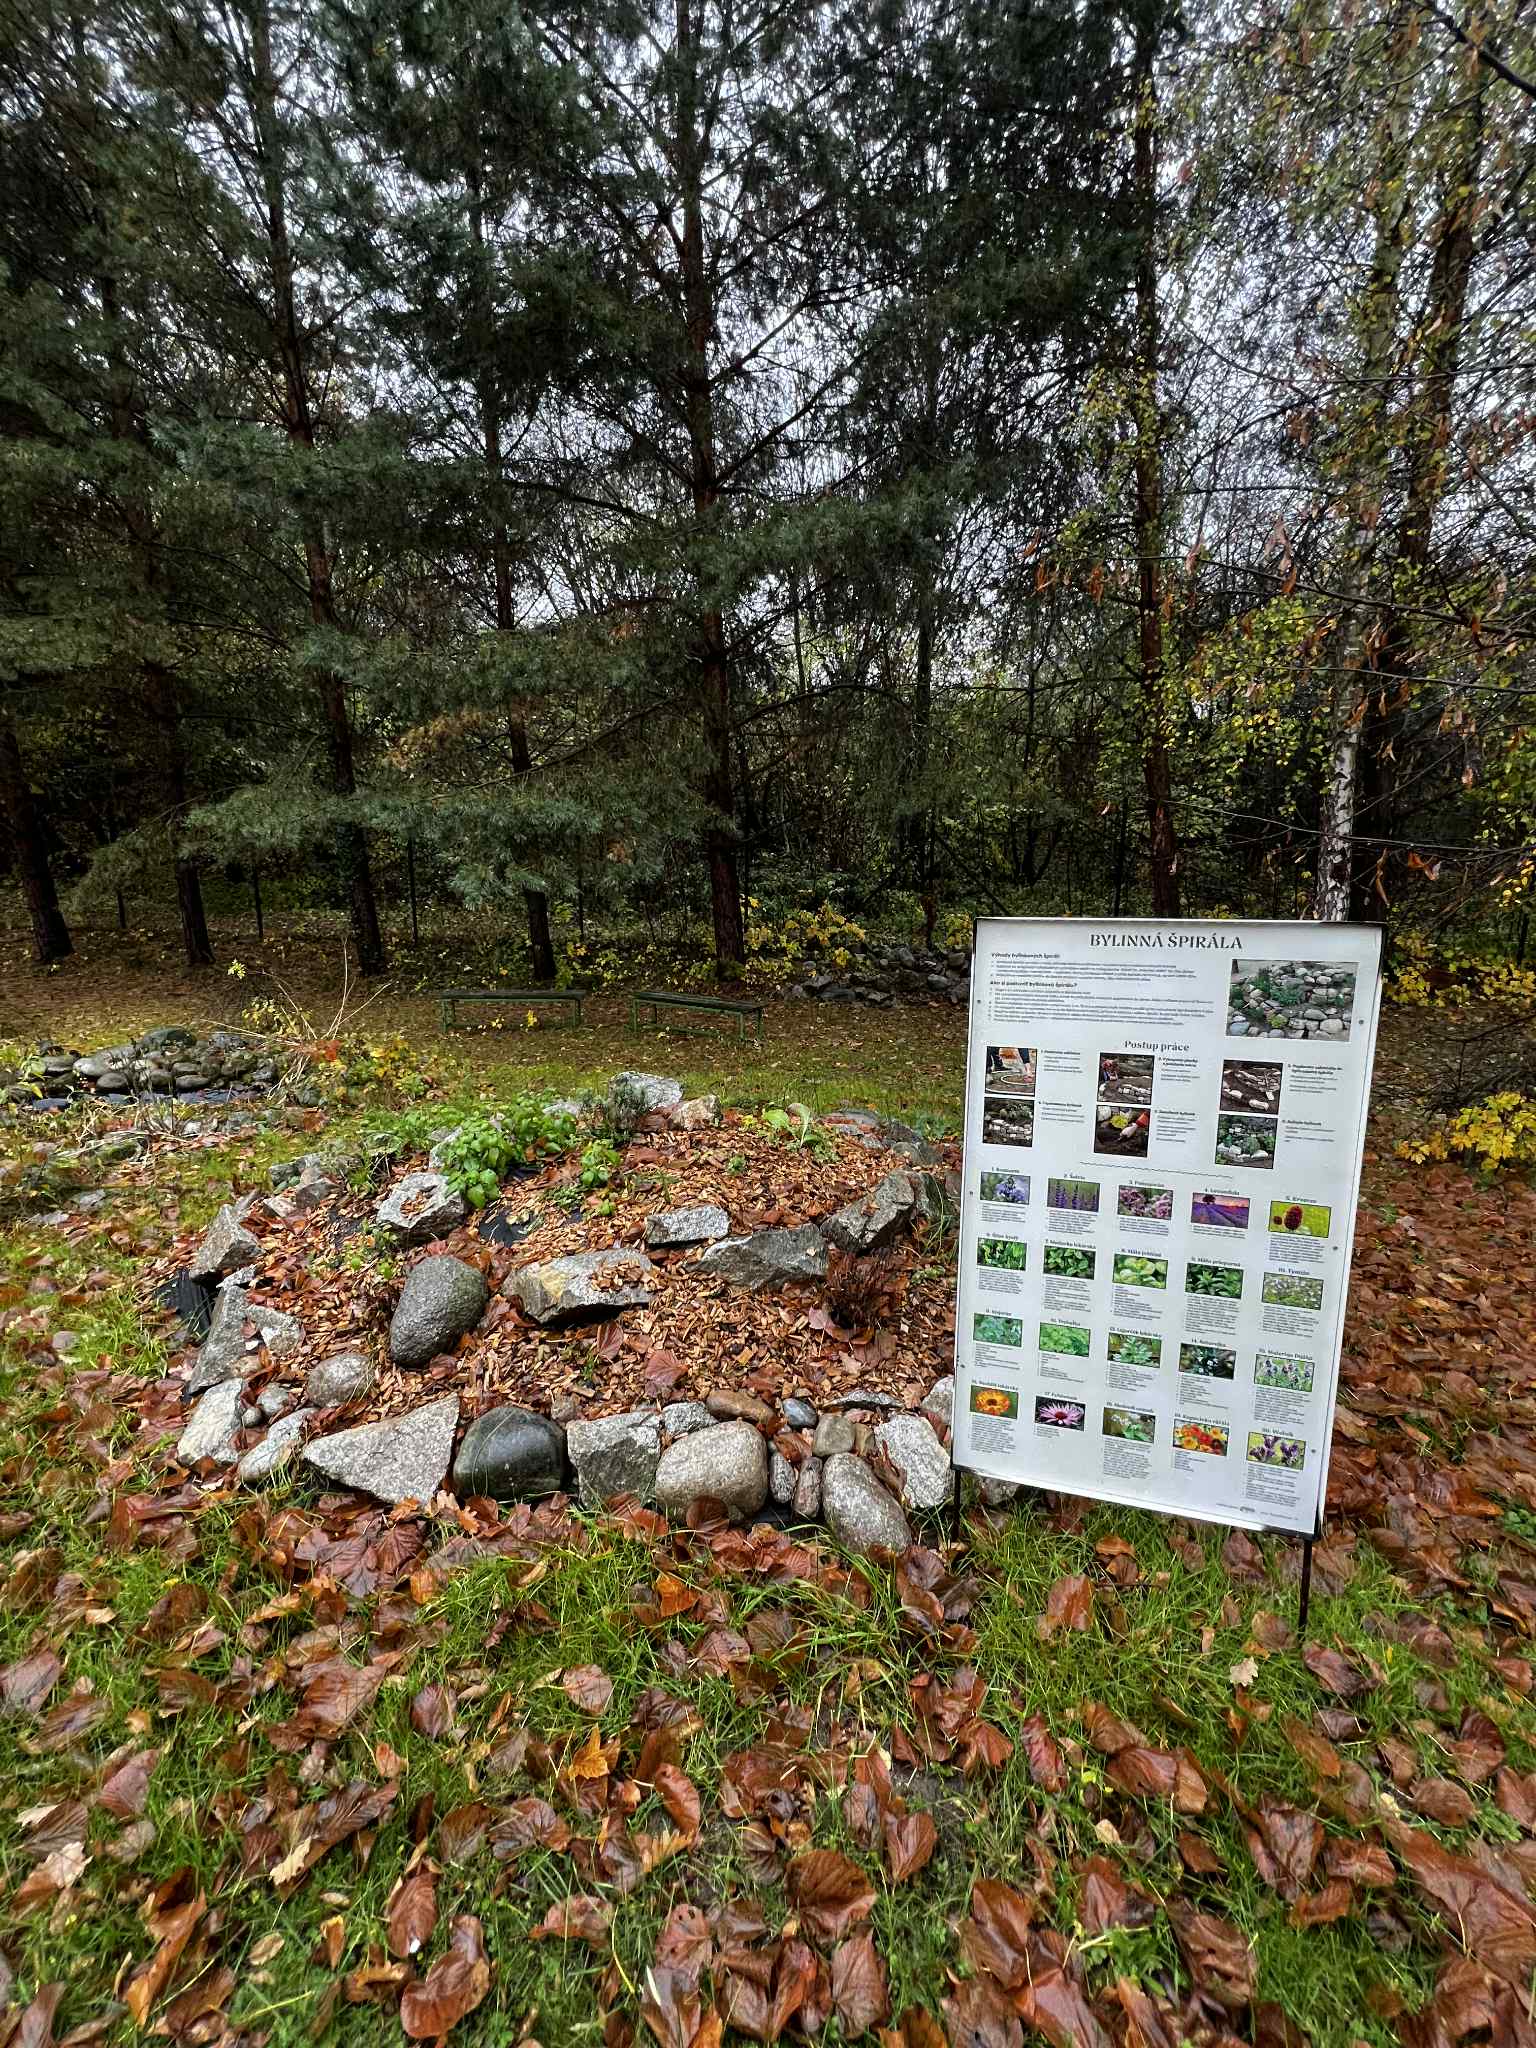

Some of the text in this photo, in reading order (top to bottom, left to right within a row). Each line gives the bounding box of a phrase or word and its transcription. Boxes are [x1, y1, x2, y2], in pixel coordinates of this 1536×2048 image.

[1090, 932, 1242, 949] BYLINNÁ ŠPIRÁLA
[1125, 1040, 1190, 1053] Postup práce
